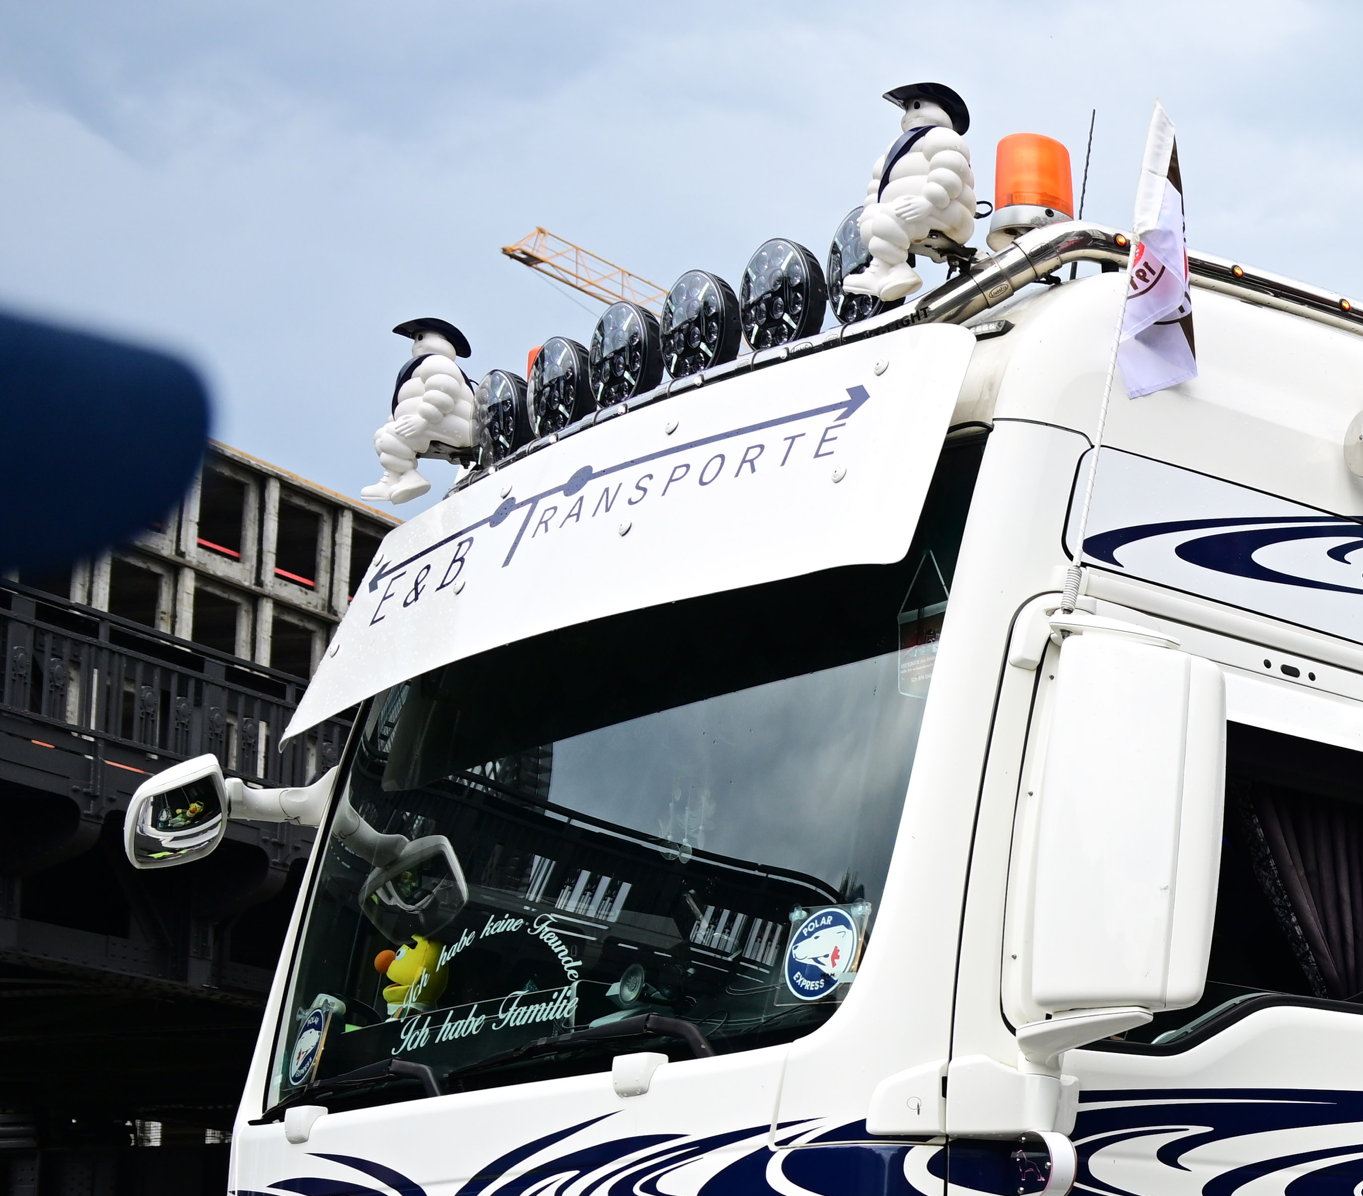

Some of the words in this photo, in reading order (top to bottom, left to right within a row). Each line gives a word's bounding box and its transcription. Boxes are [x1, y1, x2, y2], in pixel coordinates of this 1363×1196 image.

[369, 536, 474, 627] E&B
[501, 422, 847, 568] TRANSPORTE
[436, 928, 476, 972] habe
[480, 913, 524, 939] keine
[527, 913, 583, 982] Freunde
[802, 915, 833, 937] POLAR
[793, 971, 825, 991] EXPRESS
[391, 1015, 431, 1056] Ich
[415, 1004, 486, 1043] habe
[491, 986, 579, 1031] Familie
